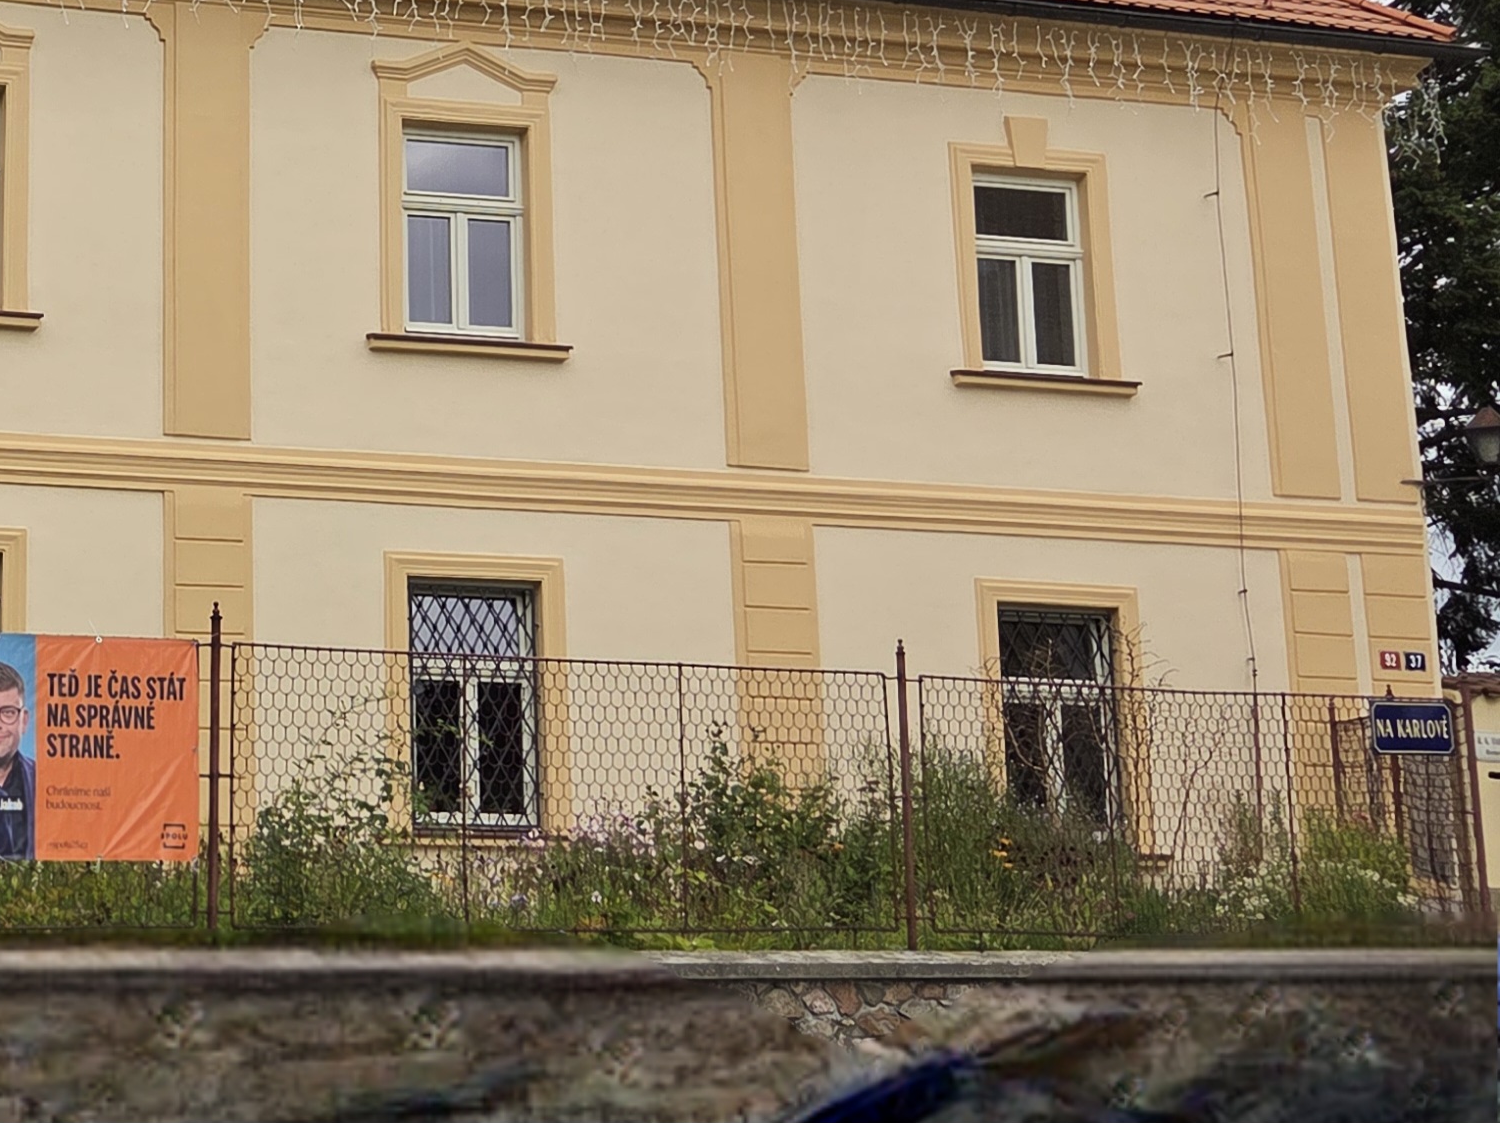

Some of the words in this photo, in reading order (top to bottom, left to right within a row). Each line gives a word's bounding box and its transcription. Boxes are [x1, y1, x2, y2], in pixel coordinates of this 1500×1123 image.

[1384, 652, 1397, 667] 92
[1409, 654, 1422, 668] 37
[47, 668, 79, 697] TEĎ
[85, 674, 102, 698] JE
[107, 669, 141, 700] ČAS
[146, 671, 186, 701] STÁT
[47, 703, 70, 728] NA
[75, 700, 155, 730] SPRÁVNÉ
[1376, 718, 1394, 738] NA
[1396, 714, 1449, 739] KARLOVĚ
[47, 730, 120, 759] STRANĚ.
